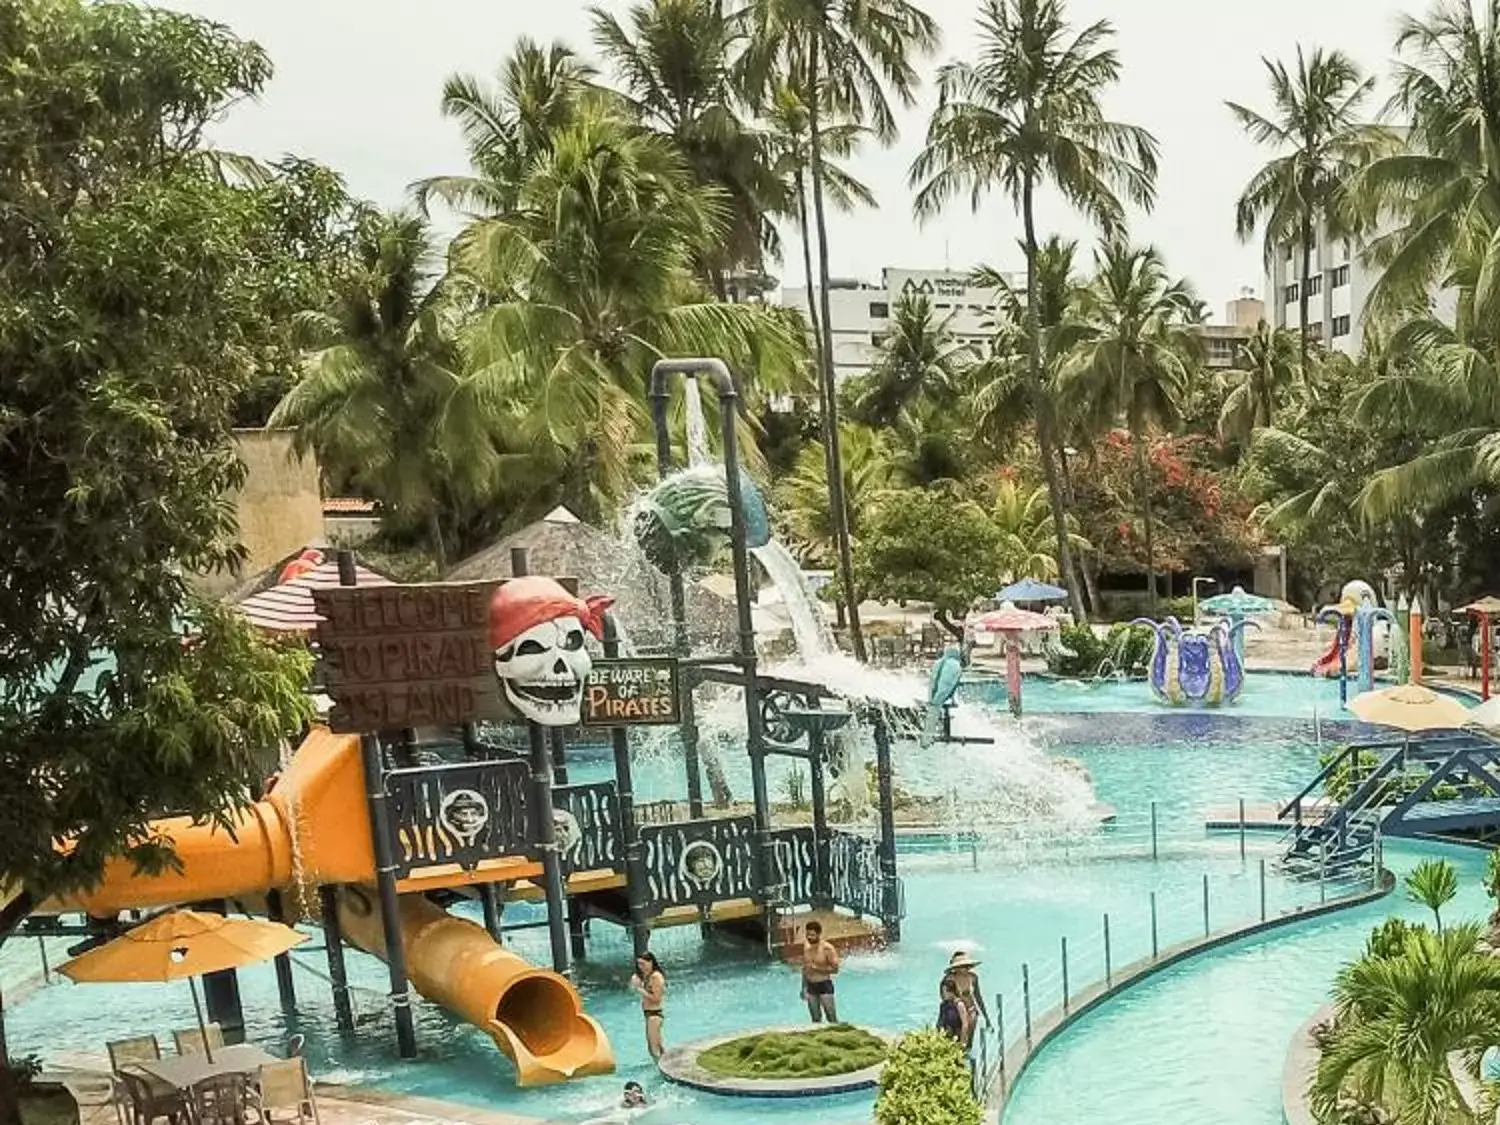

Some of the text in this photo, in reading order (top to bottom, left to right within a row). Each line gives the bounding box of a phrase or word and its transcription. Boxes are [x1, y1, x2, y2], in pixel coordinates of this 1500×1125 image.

[938, 288, 966, 297] hotel
[334, 589, 488, 629] WELCOME
[340, 635, 489, 680] TO PIRATE
[589, 668, 652, 685] BEWARE
[617, 685, 639, 699] OF
[339, 683, 475, 723] ISLAND
[585, 686, 672, 717] PIRATES
